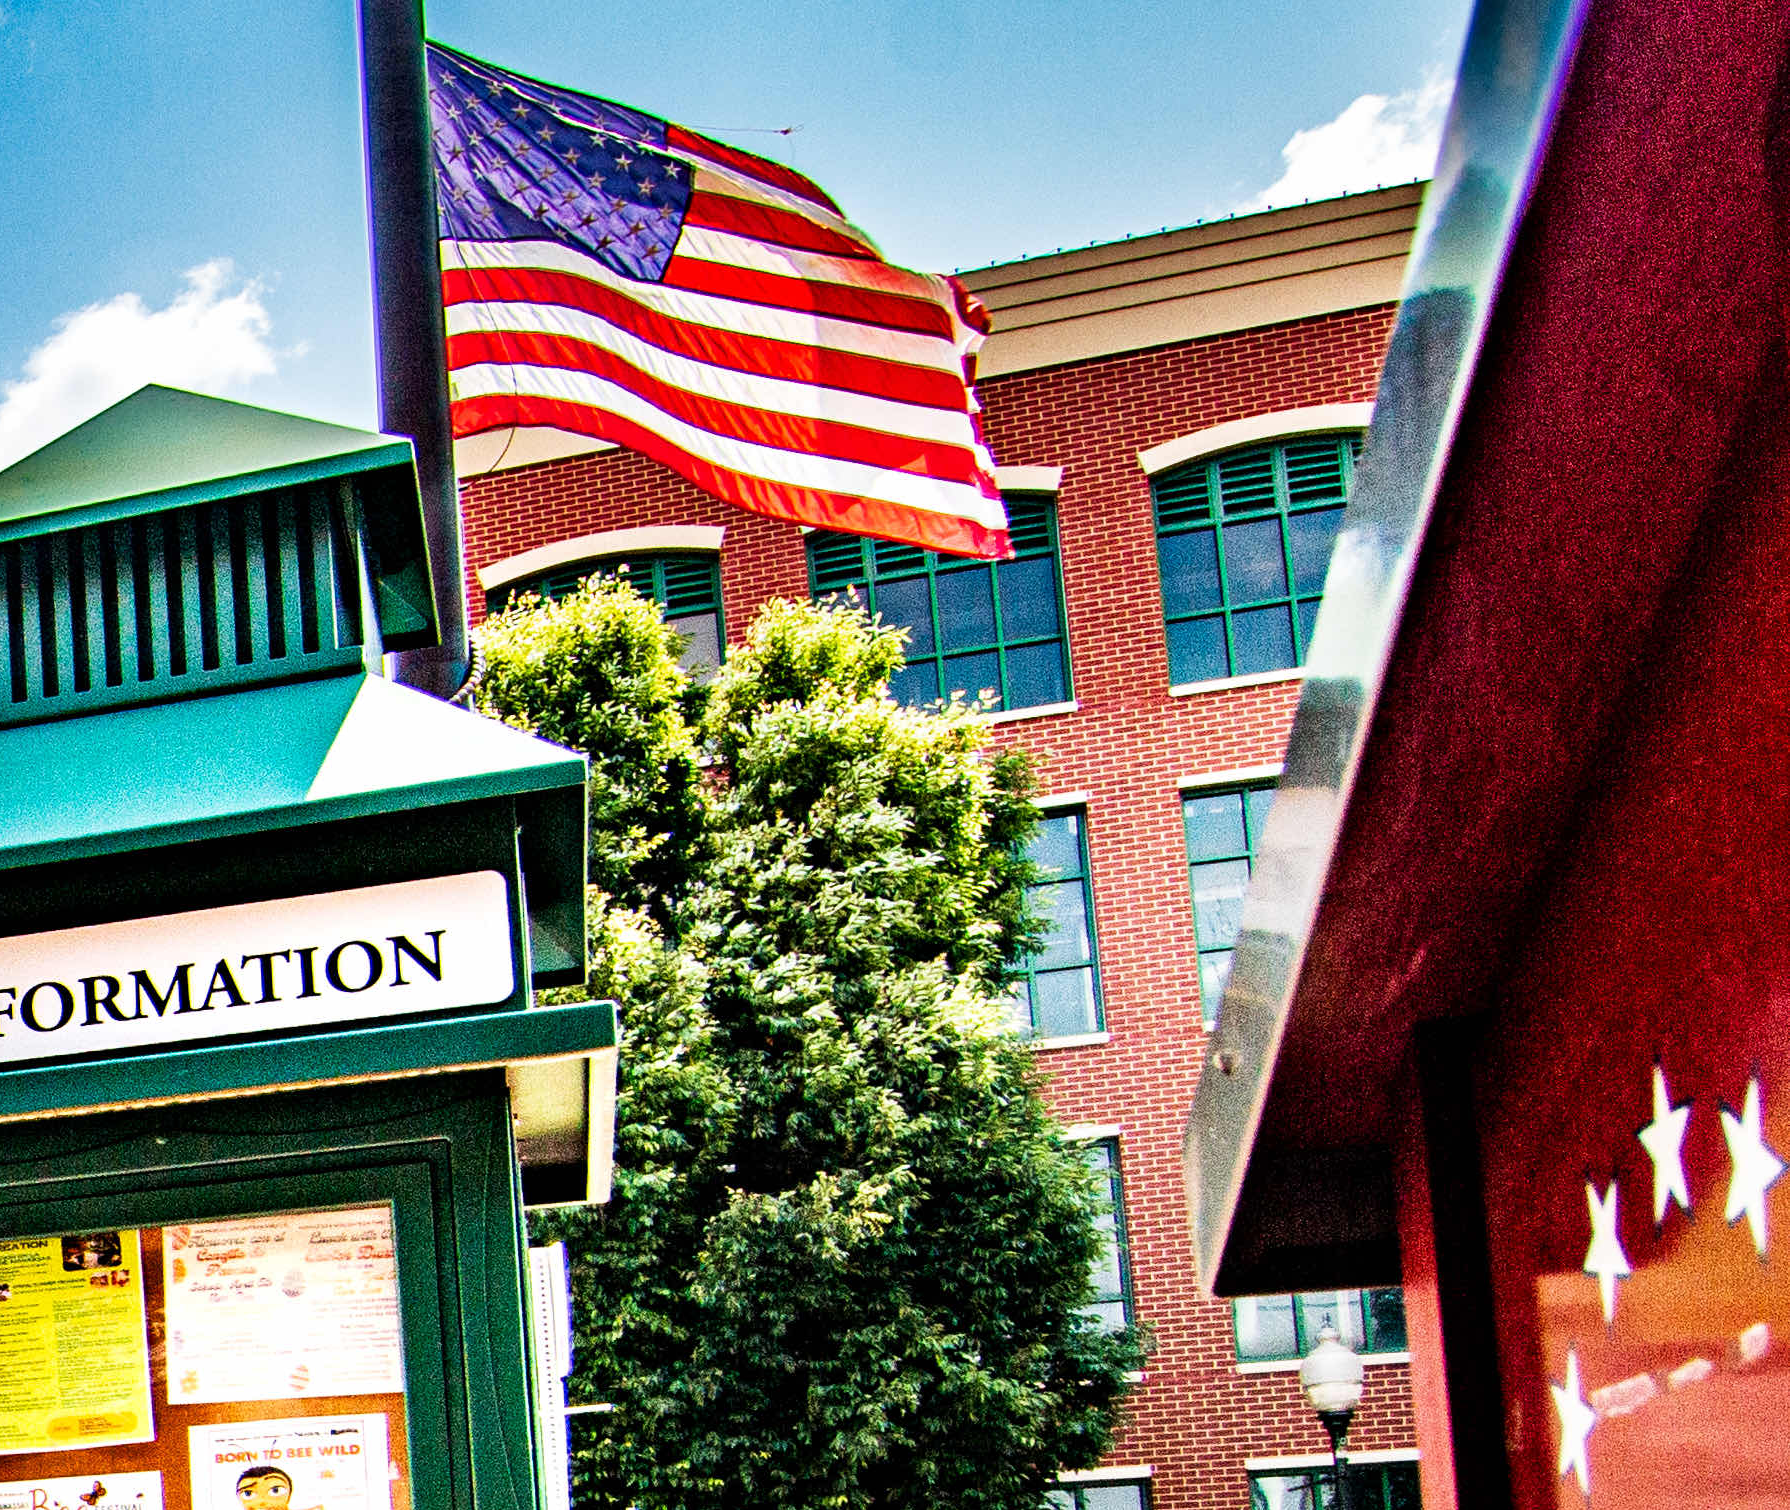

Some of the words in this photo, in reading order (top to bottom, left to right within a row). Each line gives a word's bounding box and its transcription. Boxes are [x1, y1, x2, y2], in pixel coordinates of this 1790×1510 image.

[215, 1451, 258, 1464] BORN
[263, 1449, 282, 1461] TO
[286, 1447, 313, 1458] BEE
[318, 1444, 361, 1456] WILD
